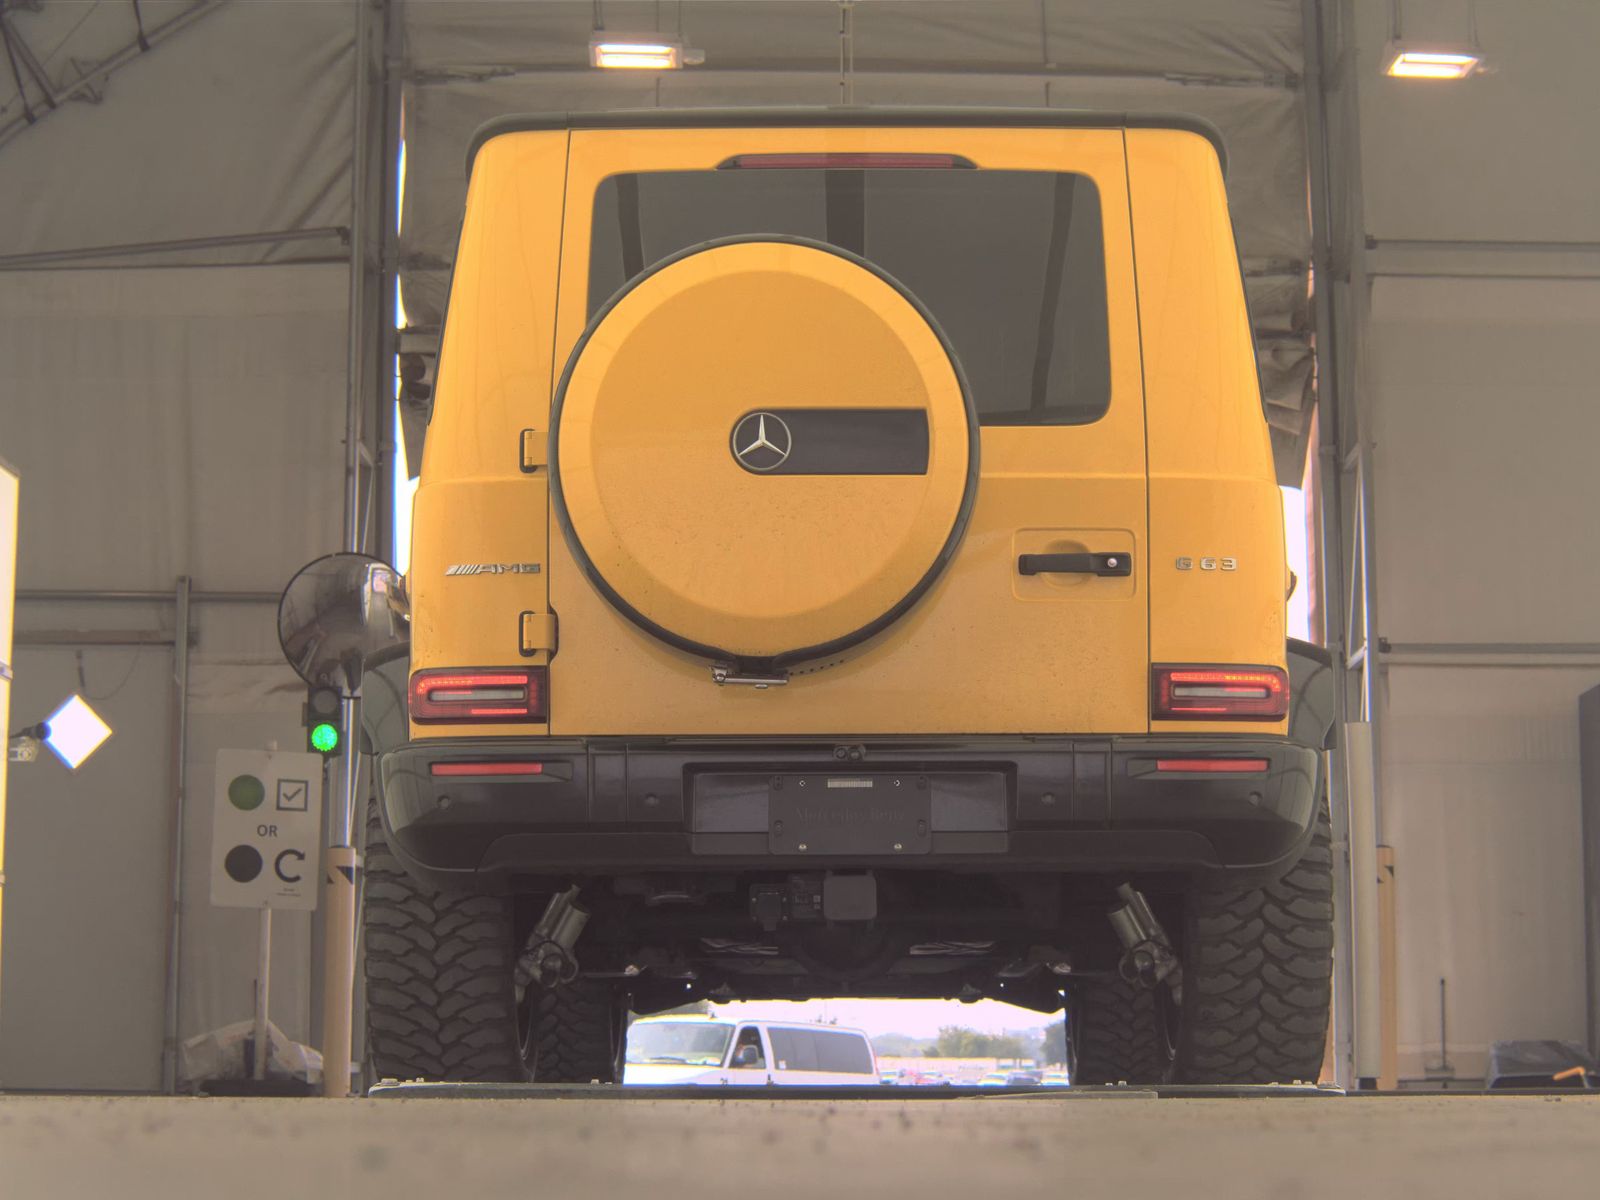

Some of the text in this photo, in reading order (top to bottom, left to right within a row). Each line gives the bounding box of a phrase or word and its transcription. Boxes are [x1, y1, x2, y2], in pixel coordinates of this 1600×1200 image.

[1176, 557, 1237, 571] G 63
[257, 824, 278, 838] OR
